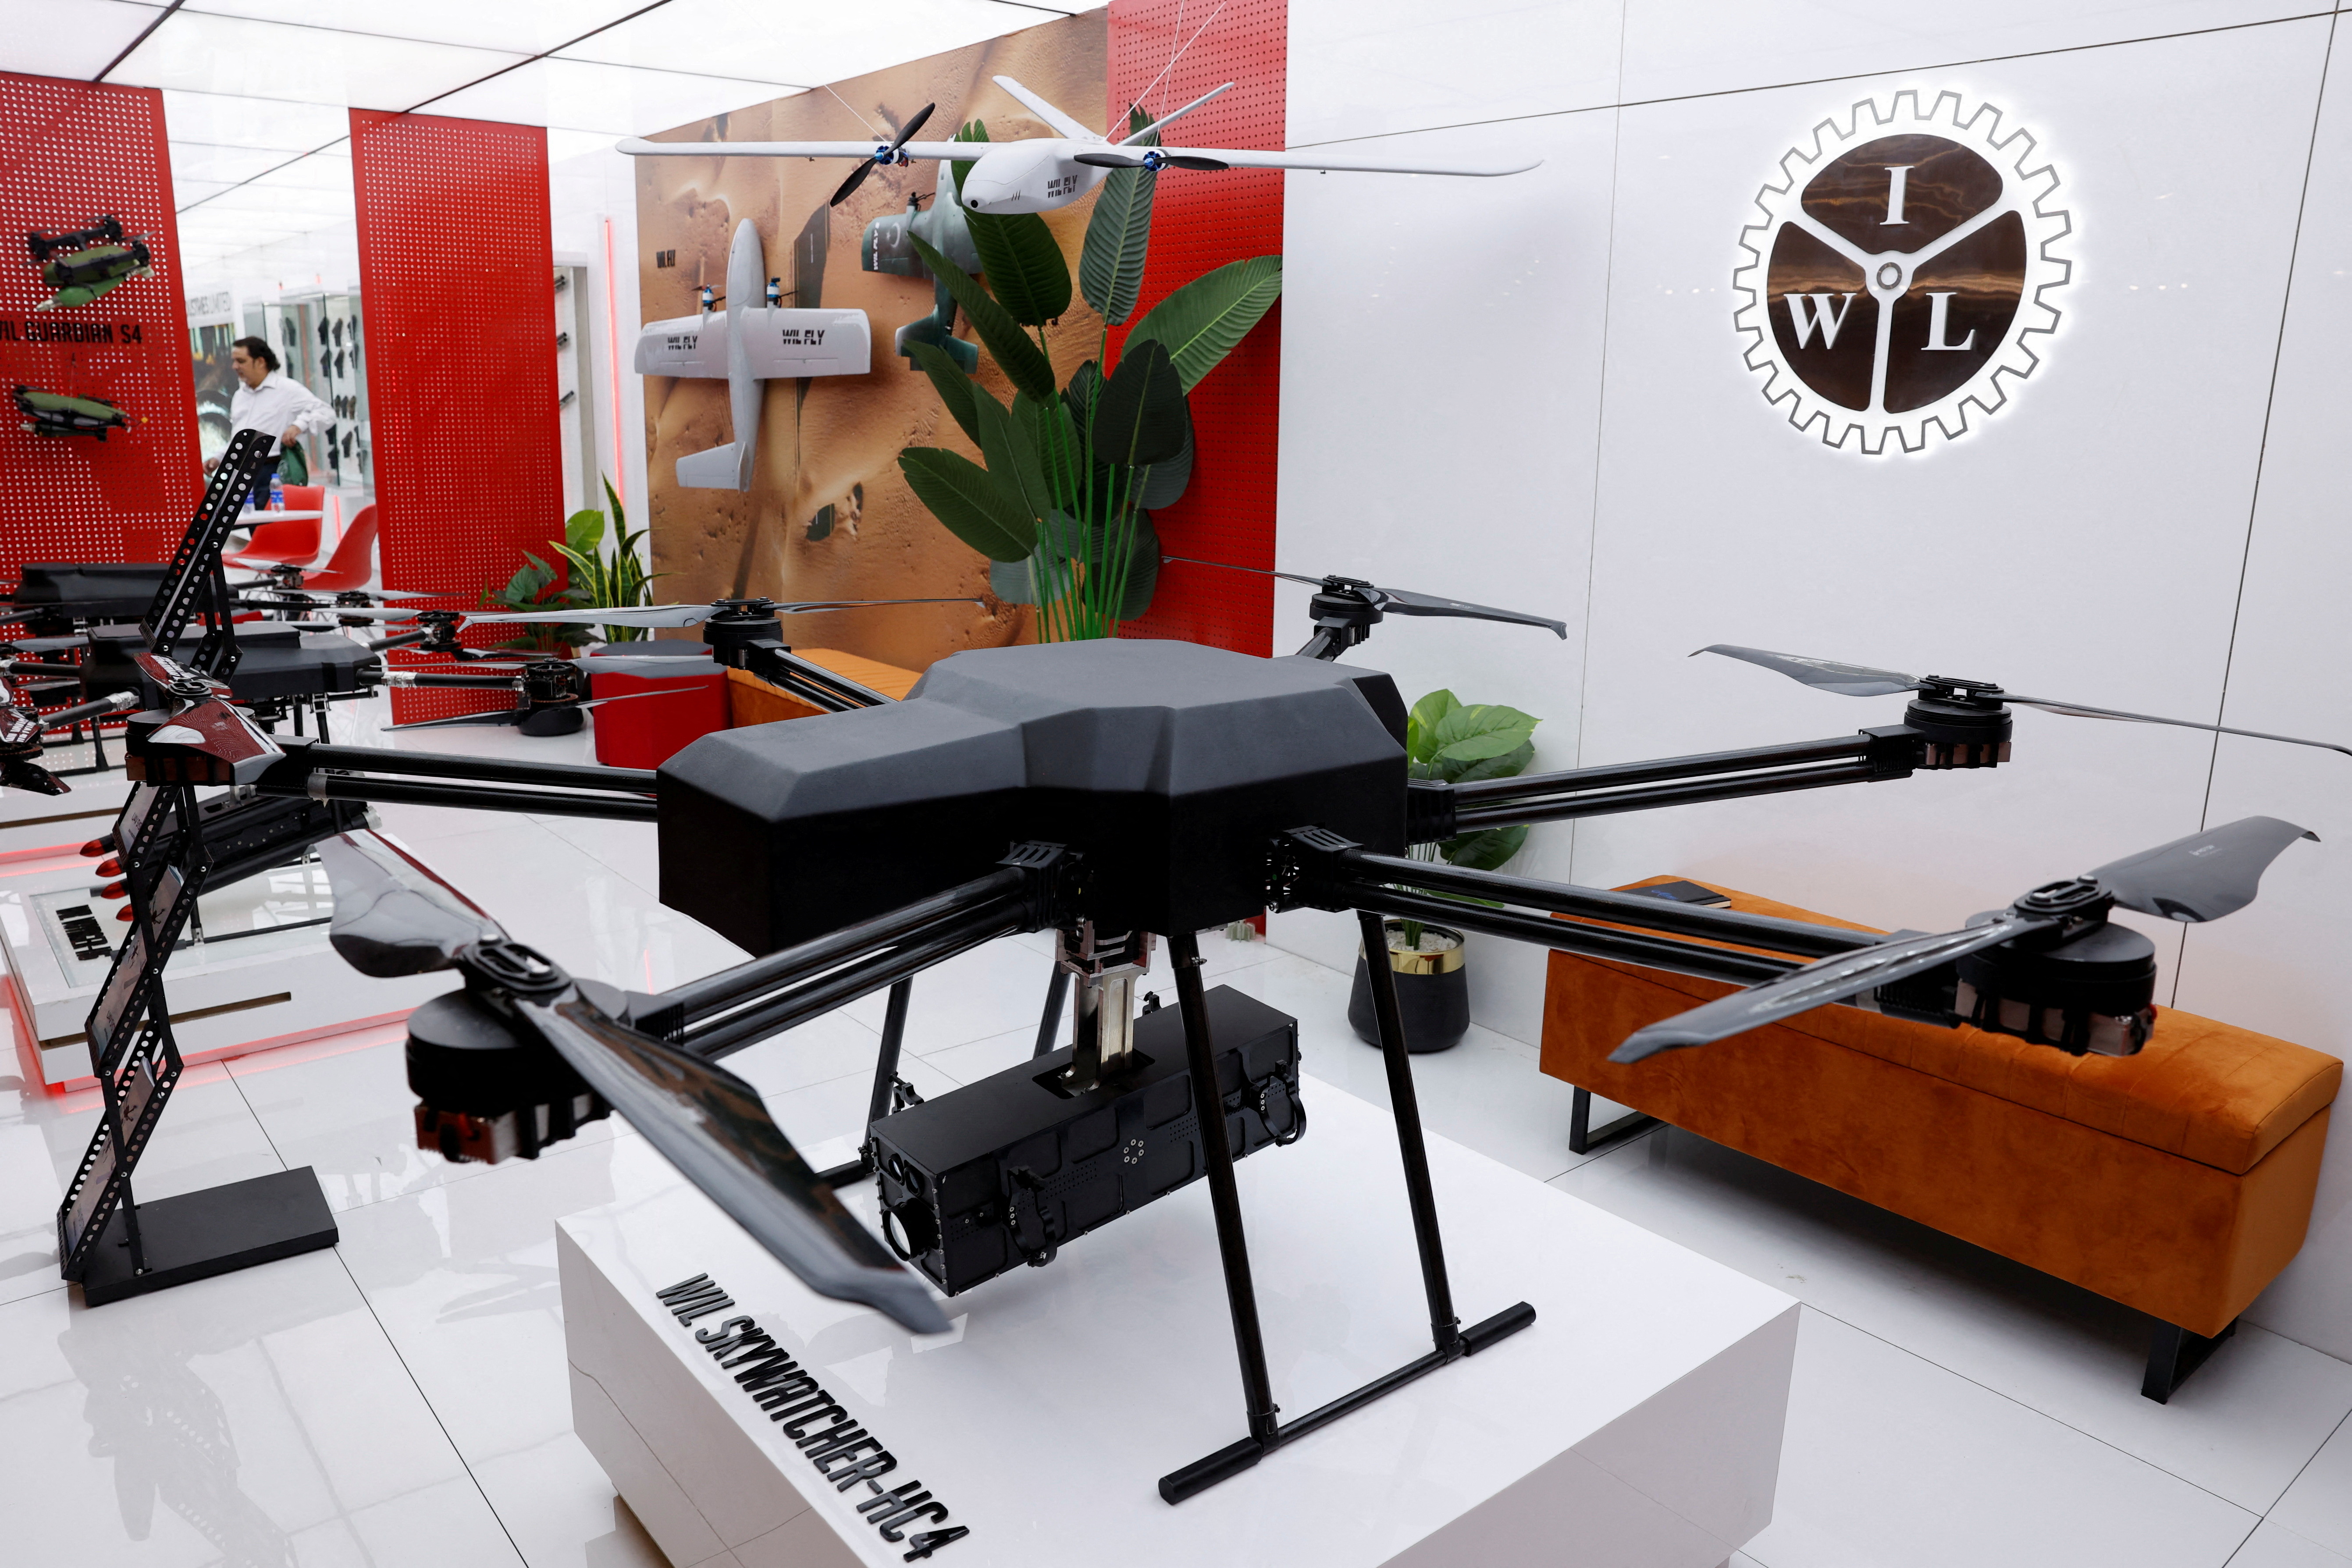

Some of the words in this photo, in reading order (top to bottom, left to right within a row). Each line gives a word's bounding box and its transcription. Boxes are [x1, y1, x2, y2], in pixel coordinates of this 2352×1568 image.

[1047, 178, 1062, 199] WIL
[1063, 174, 1078, 195] FLY
[0, 320, 21, 341] IL
[25, 321, 114, 344] GUARDIAN
[121, 324, 142, 344] S4
[668, 336, 682, 350] WIL
[683, 335, 698, 350] FLY
[783, 330, 802, 345] WIL
[804, 330, 825, 345] FLY
[655, 1272, 736, 1327] WIL
[695, 1315, 970, 1563] SKYWATCHER-HC4
